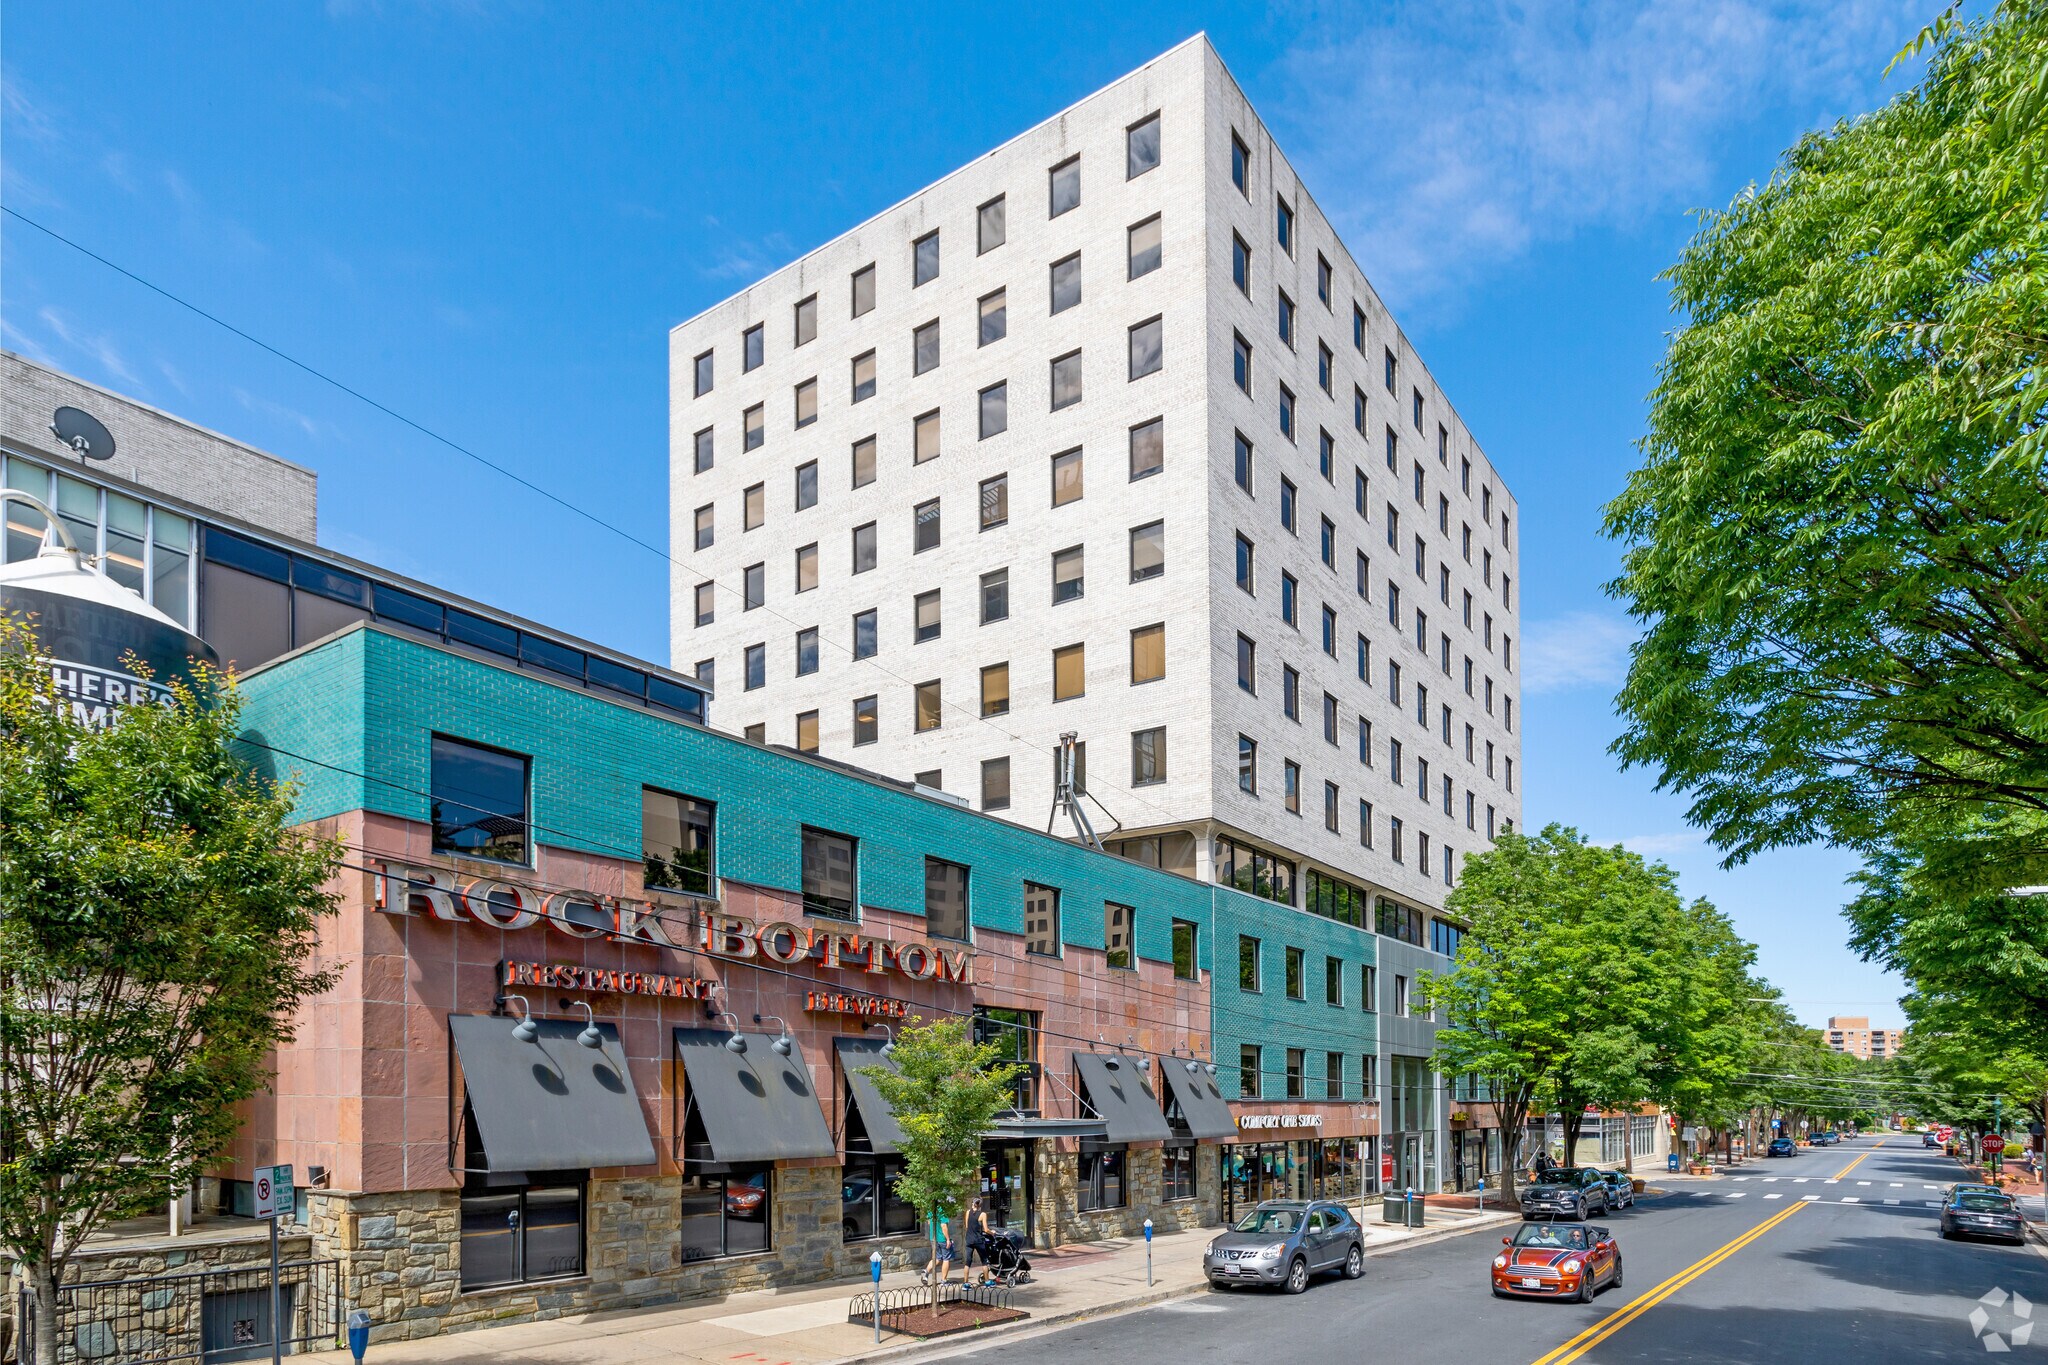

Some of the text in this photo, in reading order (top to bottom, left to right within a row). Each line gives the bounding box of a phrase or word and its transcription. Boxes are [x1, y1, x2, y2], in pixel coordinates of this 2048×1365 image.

[35, 664, 176, 717] HERE'S
[370, 858, 977, 986] ROCK BOTTOM
[504, 960, 718, 1000] RESTAURANT
[806, 991, 912, 1018] BREWERY
[1240, 1114, 1322, 1129] COMFORT ONE SHOES
[1983, 1140, 2004, 1148] STOP
